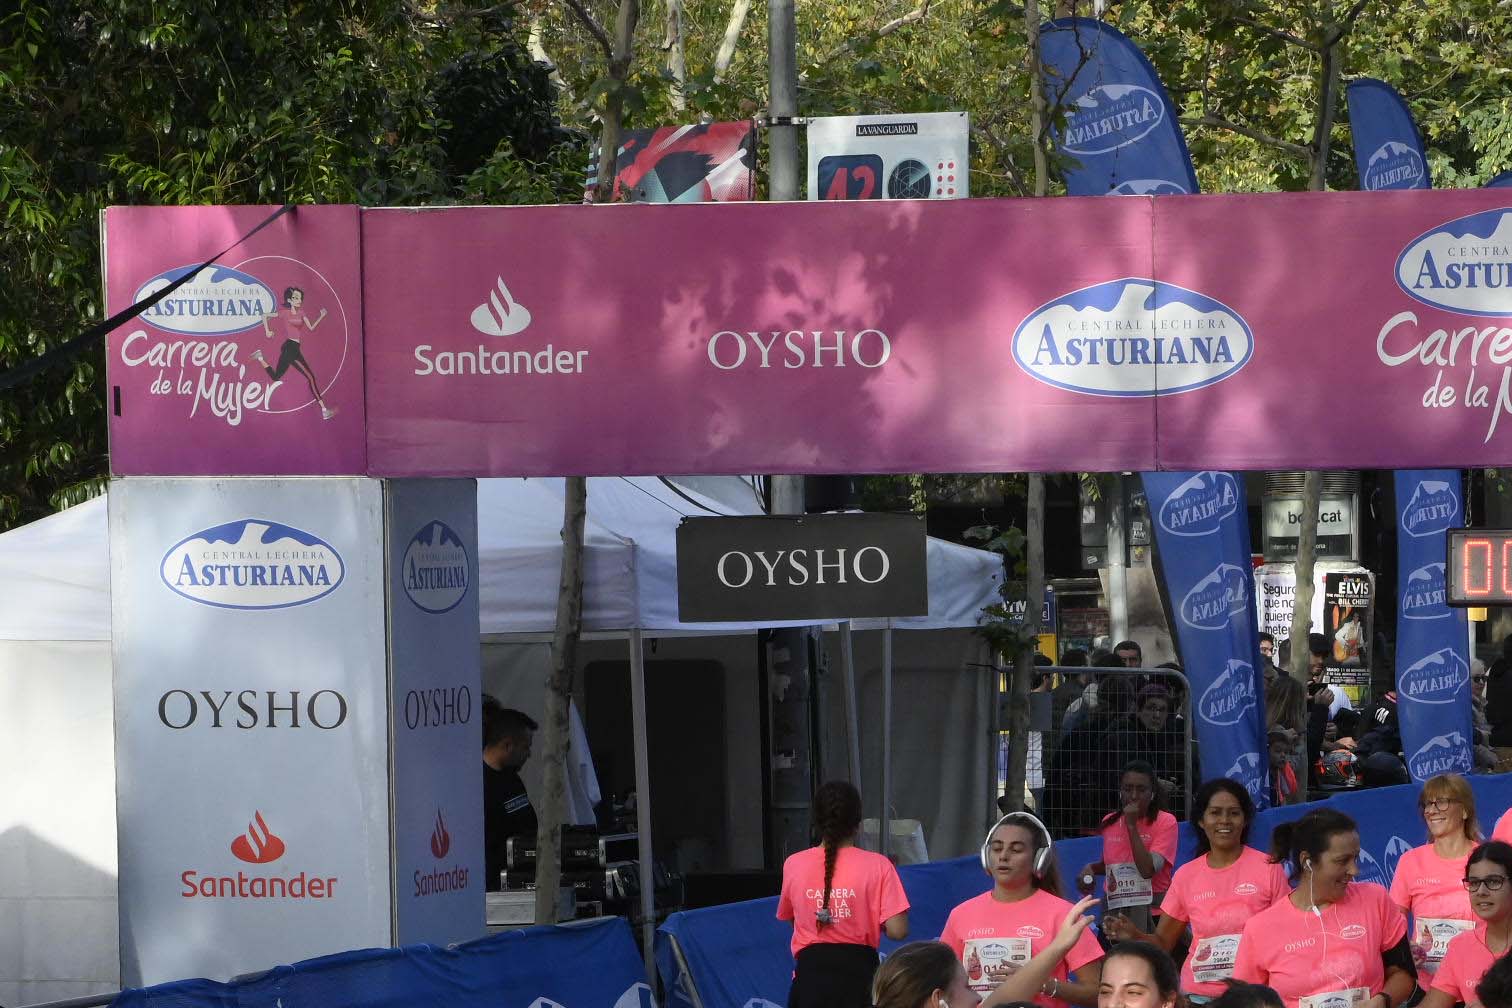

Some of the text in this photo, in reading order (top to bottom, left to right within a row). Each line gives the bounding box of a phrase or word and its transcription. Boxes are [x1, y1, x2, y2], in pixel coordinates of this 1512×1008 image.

[867, 124, 916, 135] VANGUARDIA
[1068, 319, 1227, 331] CENTRAL LECHERA
[121, 330, 238, 367] Carrera
[707, 330, 891, 369] OYSHO
[1032, 322, 1235, 367] ASTURIANA
[414, 345, 589, 376] Santander
[151, 370, 193, 395] de la
[190, 365, 283, 426] Mujer
[1422, 369, 1489, 408] de la
[175, 553, 331, 586] ASTURIANA
[203, 551, 325, 560] CENTRAL LECHERA
[717, 546, 890, 588] OYSHO
[408, 556, 465, 590] ASTURIANA
[1339, 582, 1369, 595] ELVIS
[1264, 600, 1280, 610] que
[158, 690, 347, 729] OYSHO
[405, 685, 471, 730] OYSHO
[181, 871, 337, 899] Santander
[414, 867, 469, 897] Santander
[806, 889, 856, 899] CARERA
[835, 900, 848, 908] LA
